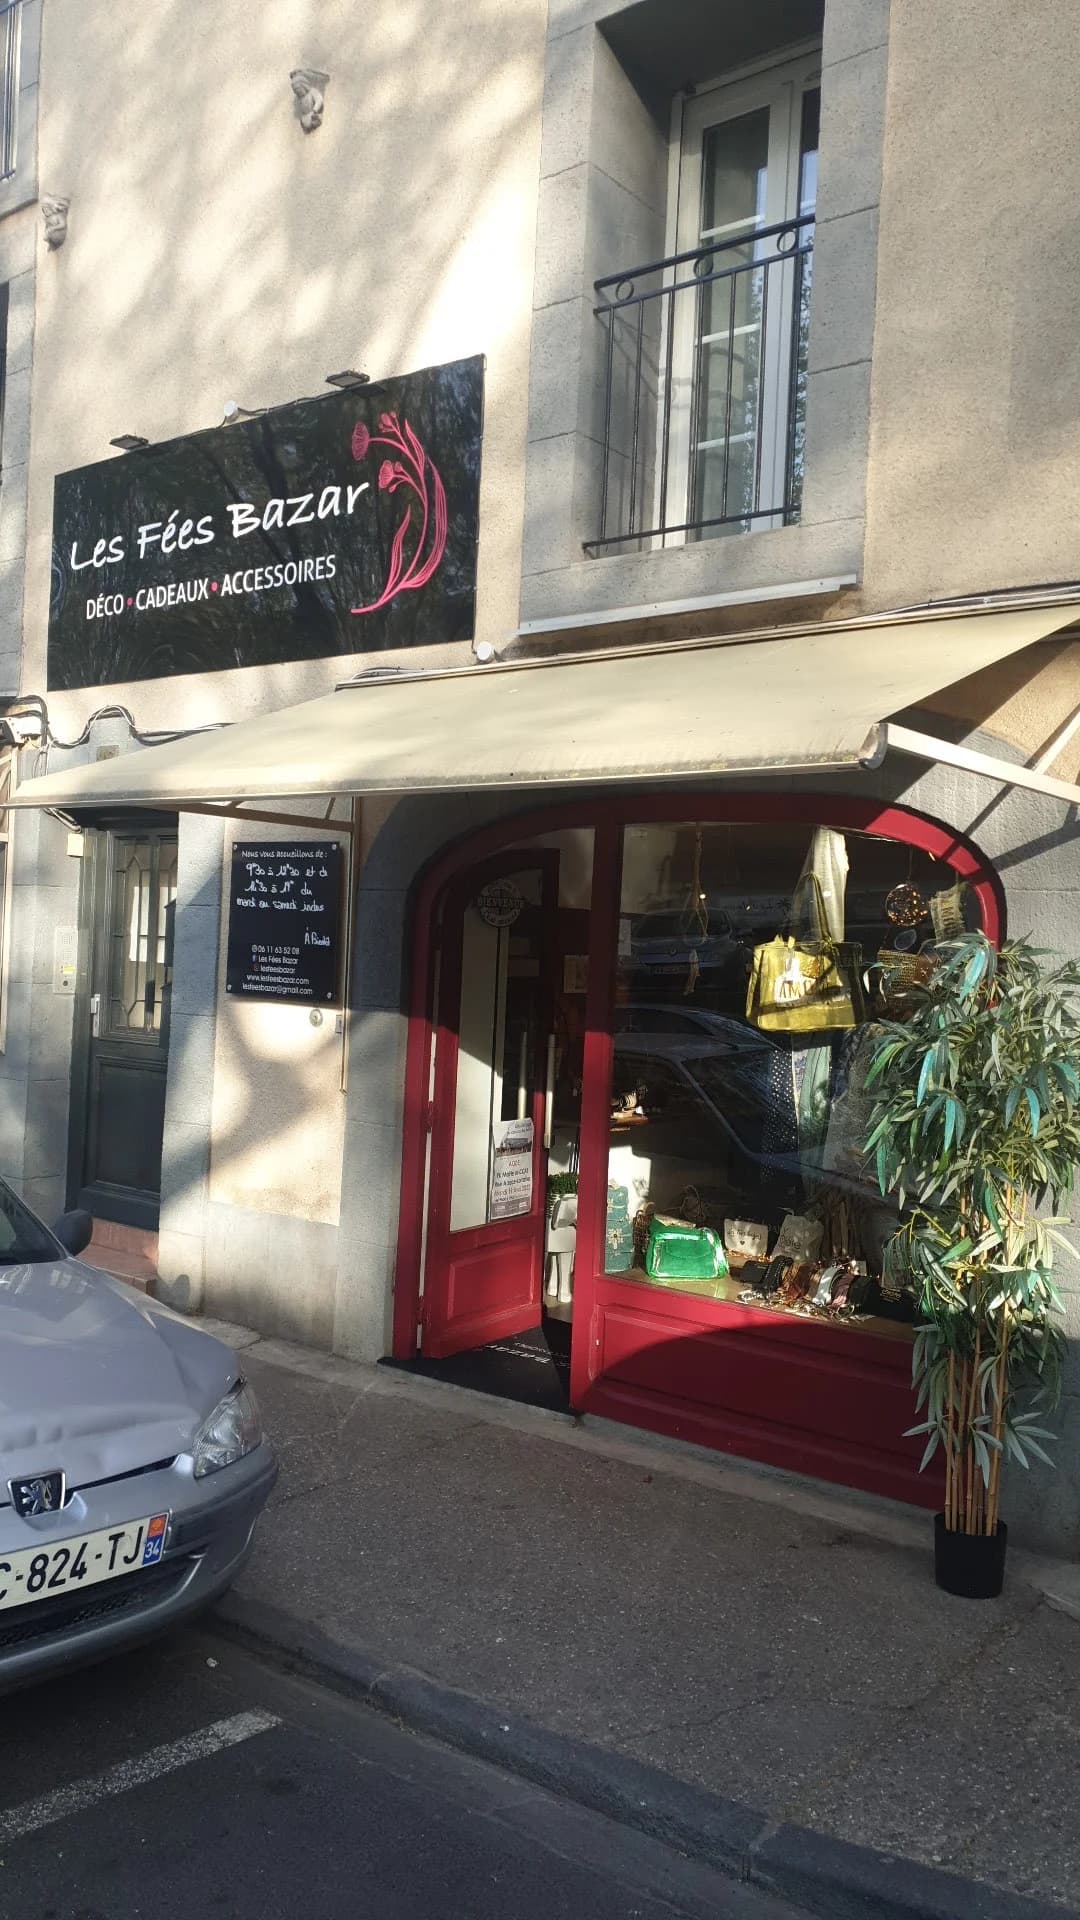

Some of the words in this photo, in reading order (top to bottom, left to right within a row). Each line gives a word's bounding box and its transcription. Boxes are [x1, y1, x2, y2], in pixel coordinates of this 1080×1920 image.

[70, 533, 125, 571] Les
[137, 508, 215, 560] Fées
[226, 480, 370, 539] Bazar
[85, 588, 124, 620] DÉCO
[135, 577, 209, 612] CADEAUX
[220, 554, 336, 598] ACCESSOIRES
[241, 850, 259, 858] Nous
[260, 850, 275, 858] vous
[276, 849, 314, 858] accueillons
[315, 849, 324, 858] de
[305, 866, 316, 877] et
[300, 881, 313, 895] du
[274, 946, 282, 954] 63
[283, 946, 290, 954] 52
[258, 955, 268, 963] Les
[268, 955, 282, 964] Fées
[144, 1540, 161, 1559] 34
